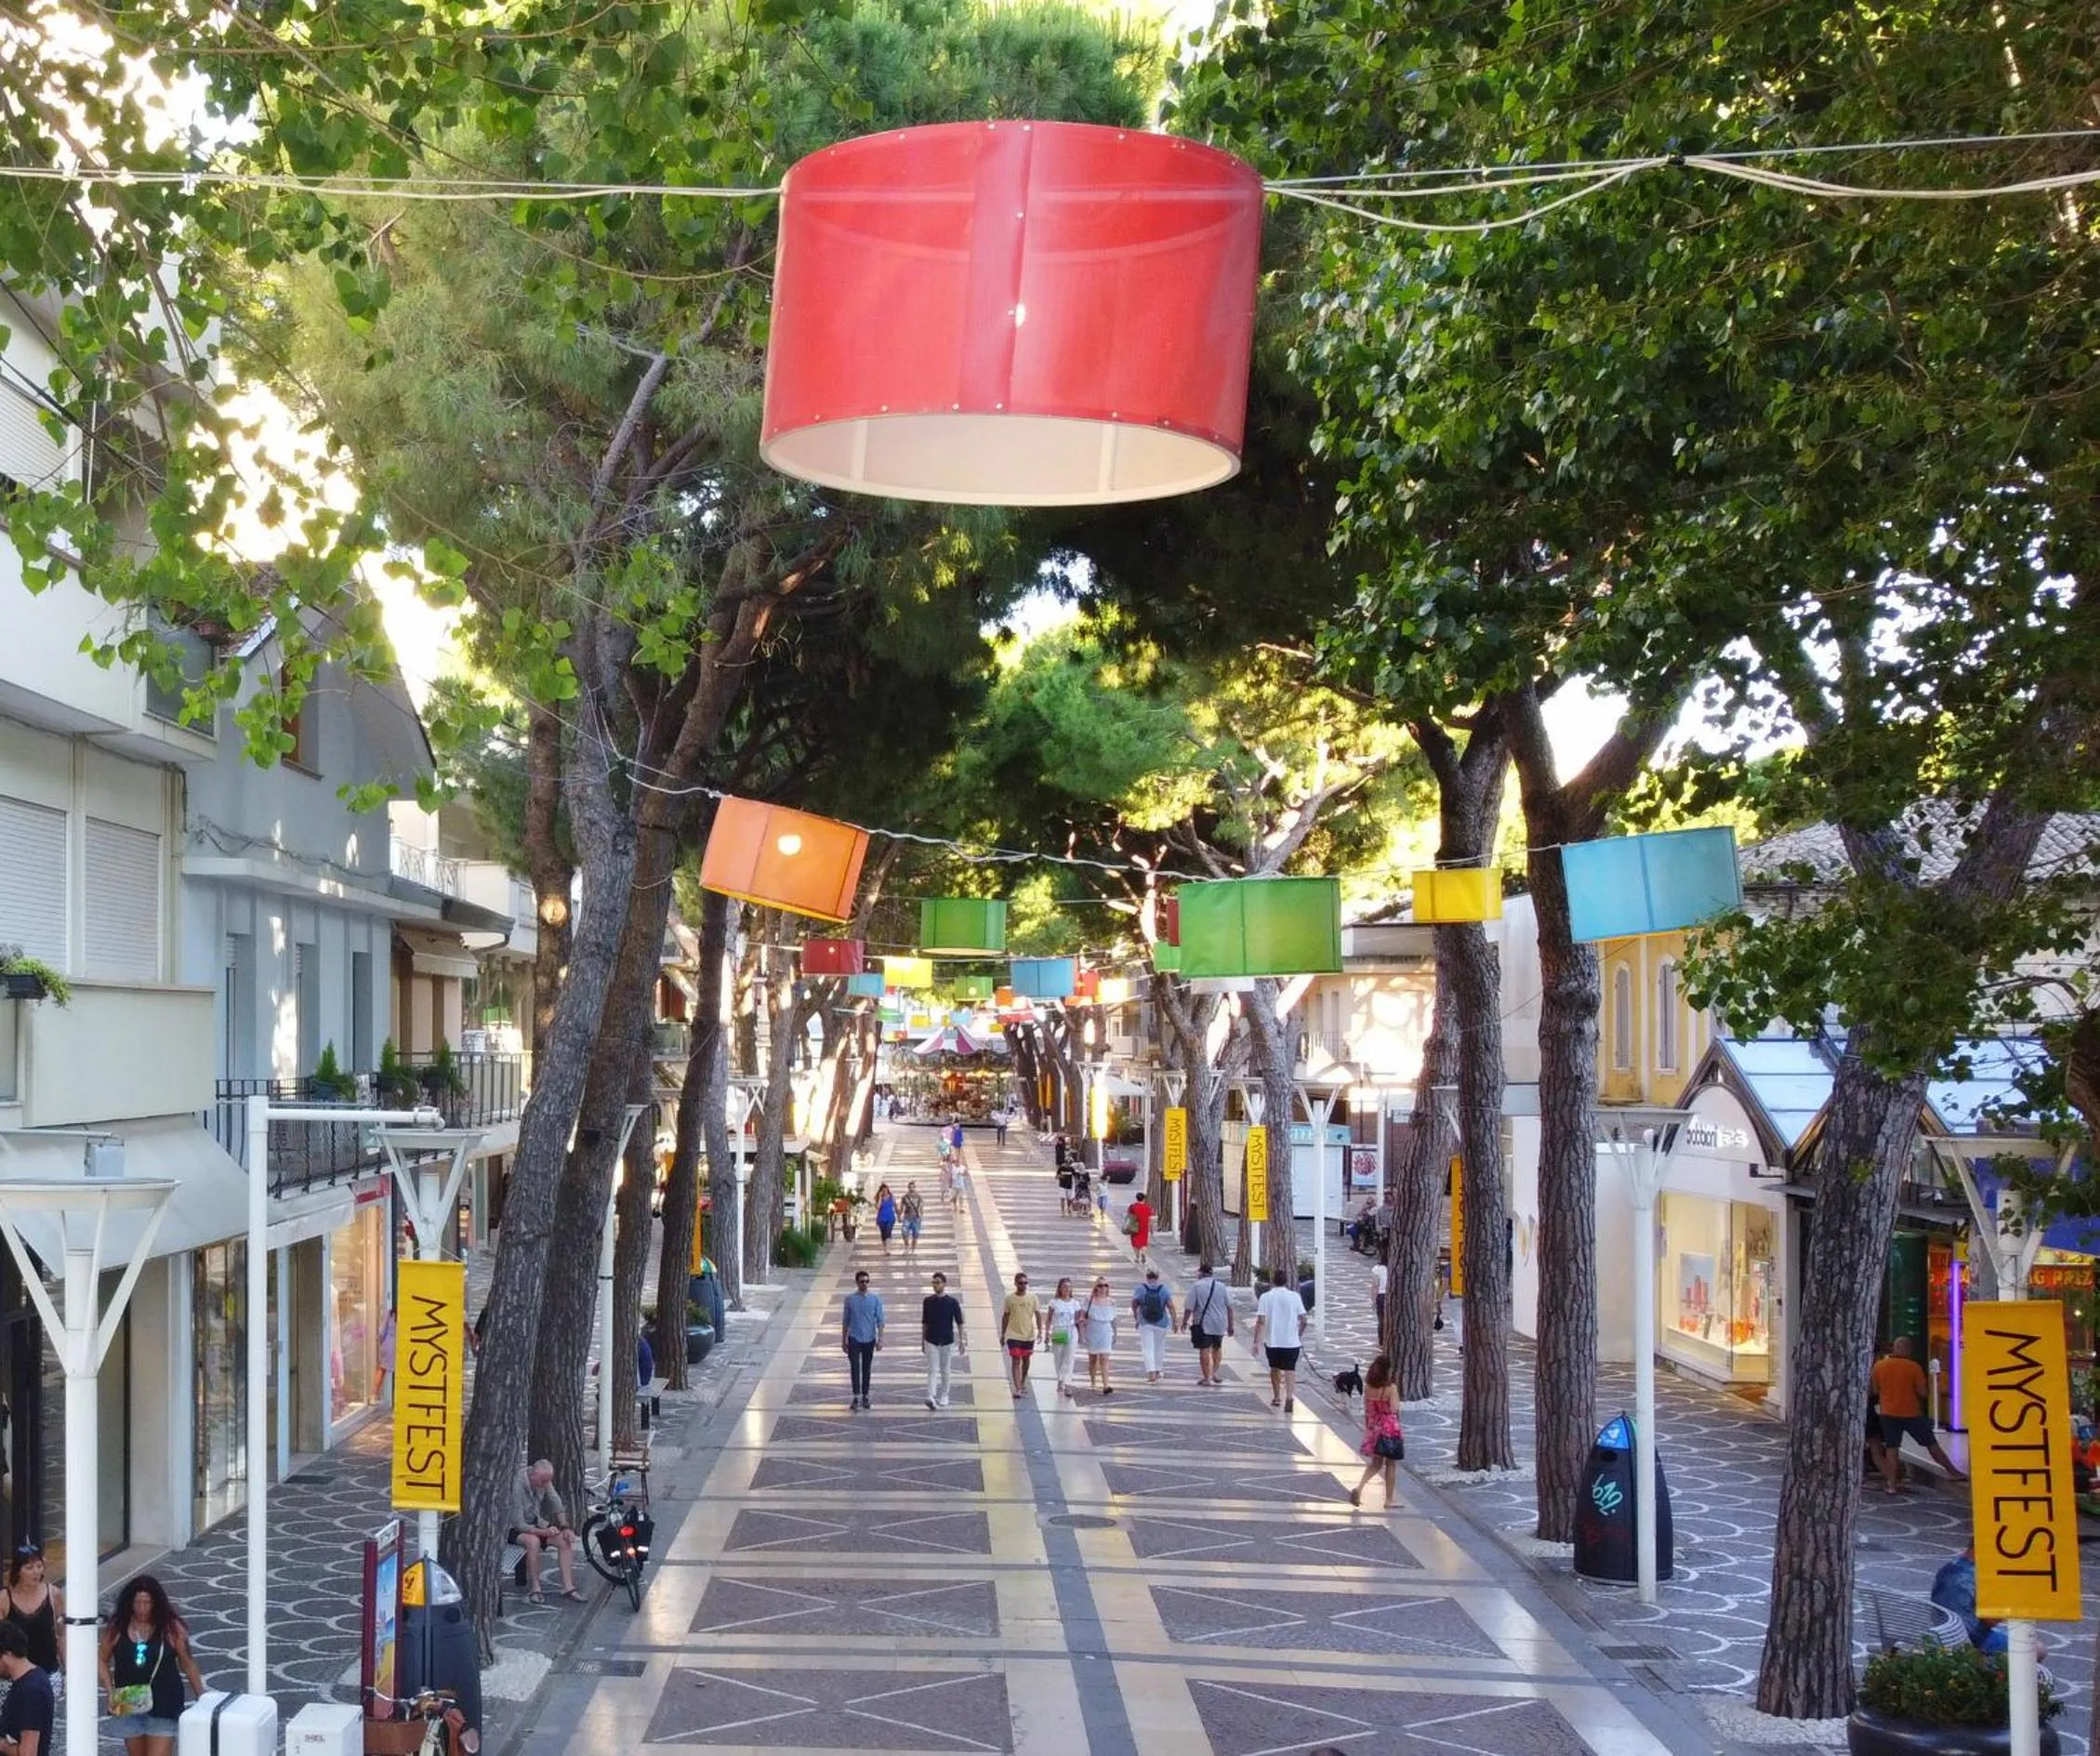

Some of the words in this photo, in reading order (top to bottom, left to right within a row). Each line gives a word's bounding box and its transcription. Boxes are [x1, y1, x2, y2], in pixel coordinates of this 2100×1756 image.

[1168, 1117, 1182, 1176] MYSTFEST
[1250, 1133, 1266, 1211] MYSTFEST
[405, 1295, 449, 1500] MYSTFEST
[1984, 1329, 2058, 1592] MYSTFEST
